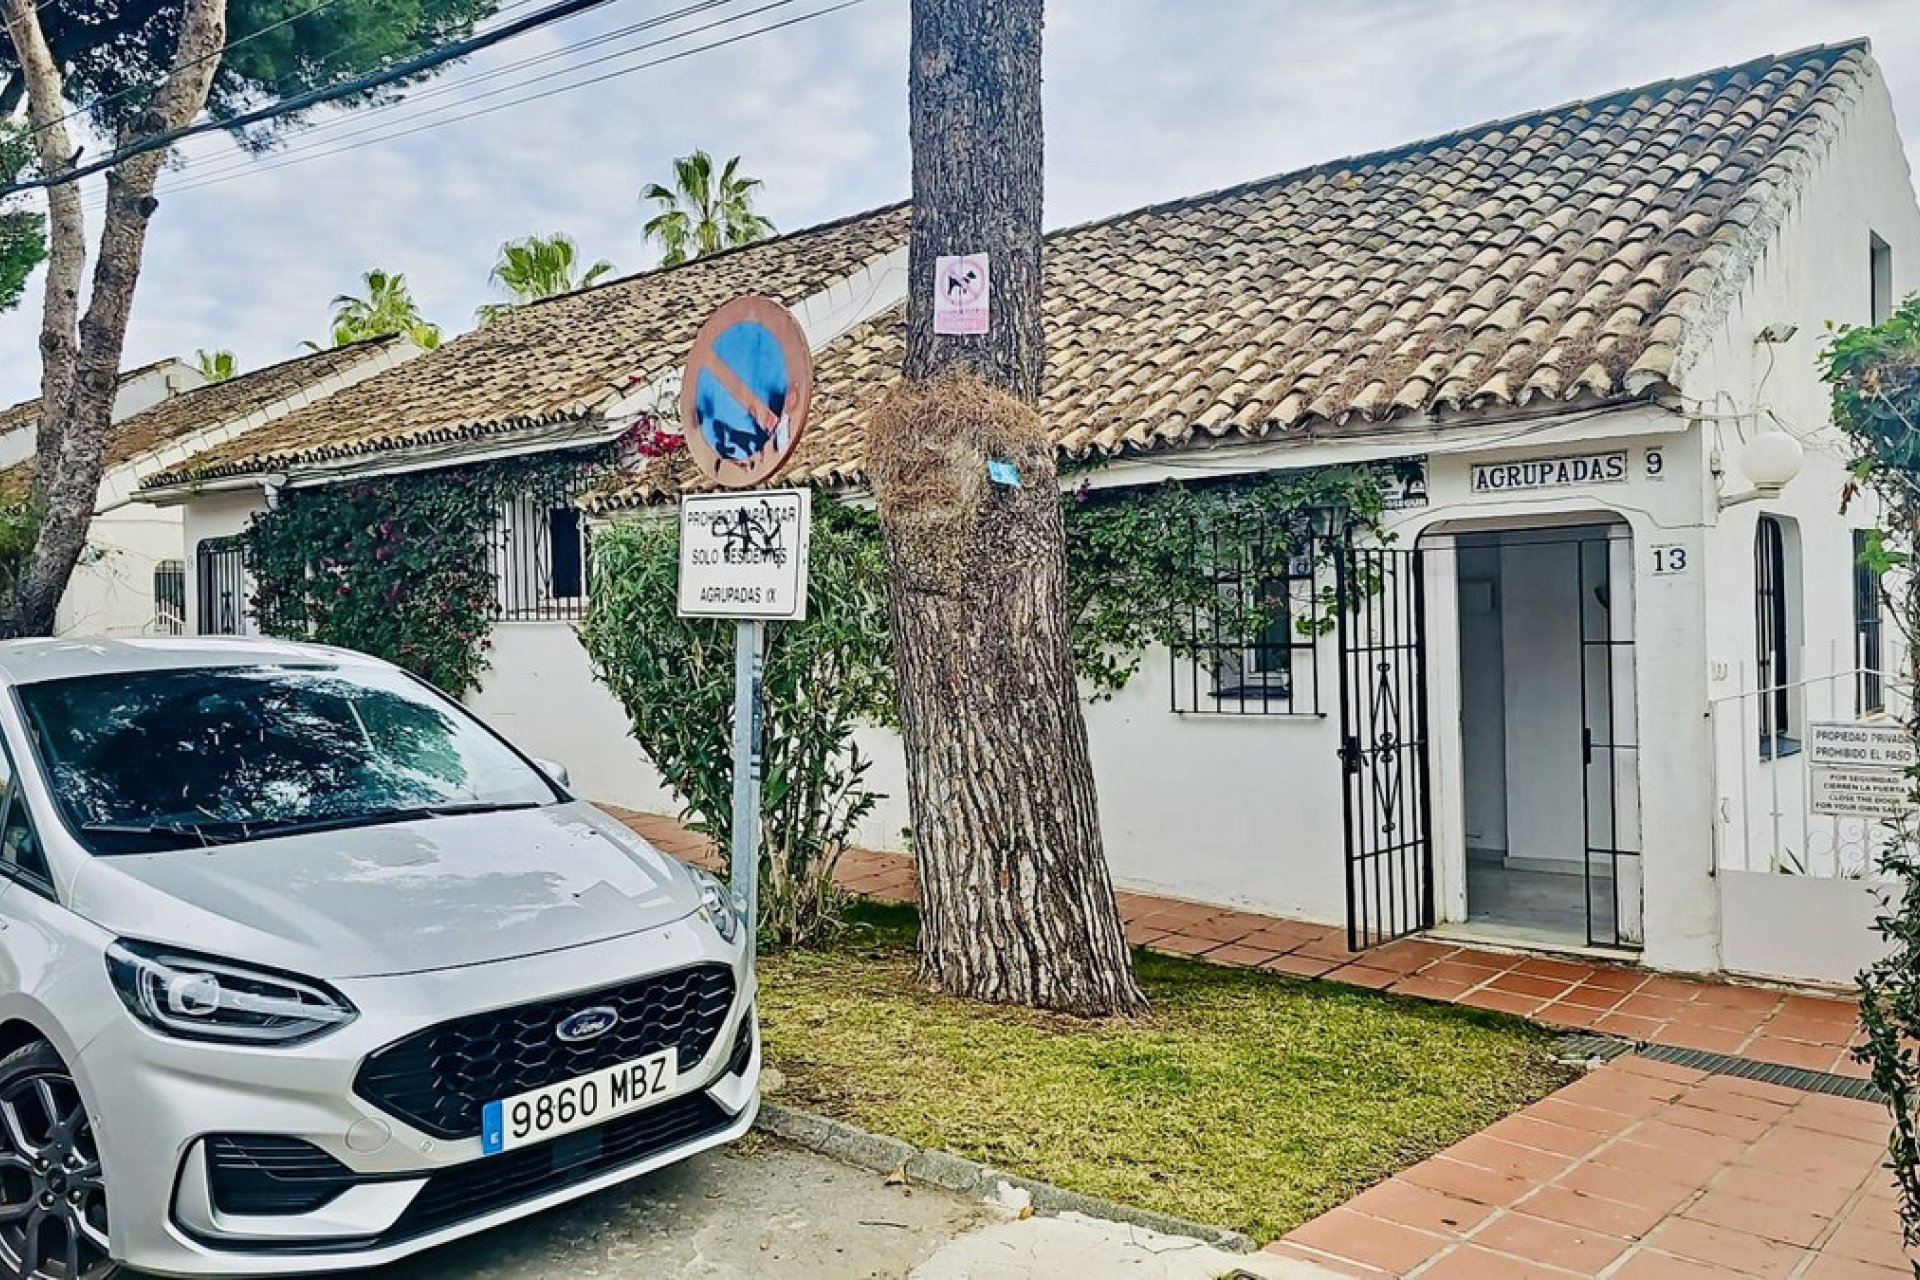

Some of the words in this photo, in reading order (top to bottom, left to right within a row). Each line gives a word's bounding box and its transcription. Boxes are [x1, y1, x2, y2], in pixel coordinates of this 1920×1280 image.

[1476, 455, 1624, 490] AGRUPADAS
[1646, 452, 1663, 475] 9
[692, 548, 719, 565] SOLO
[1653, 547, 1687, 572] 13
[700, 586, 761, 604] AGRUPADAS
[1816, 730, 1868, 743] PROPIEDAD
[1816, 746, 1867, 759] PROHIBIDO
[1870, 748, 1881, 760] EL
[1886, 750, 1912, 761] PASO
[512, 1081, 598, 1139] 9860
[610, 1057, 667, 1108] MBZ
